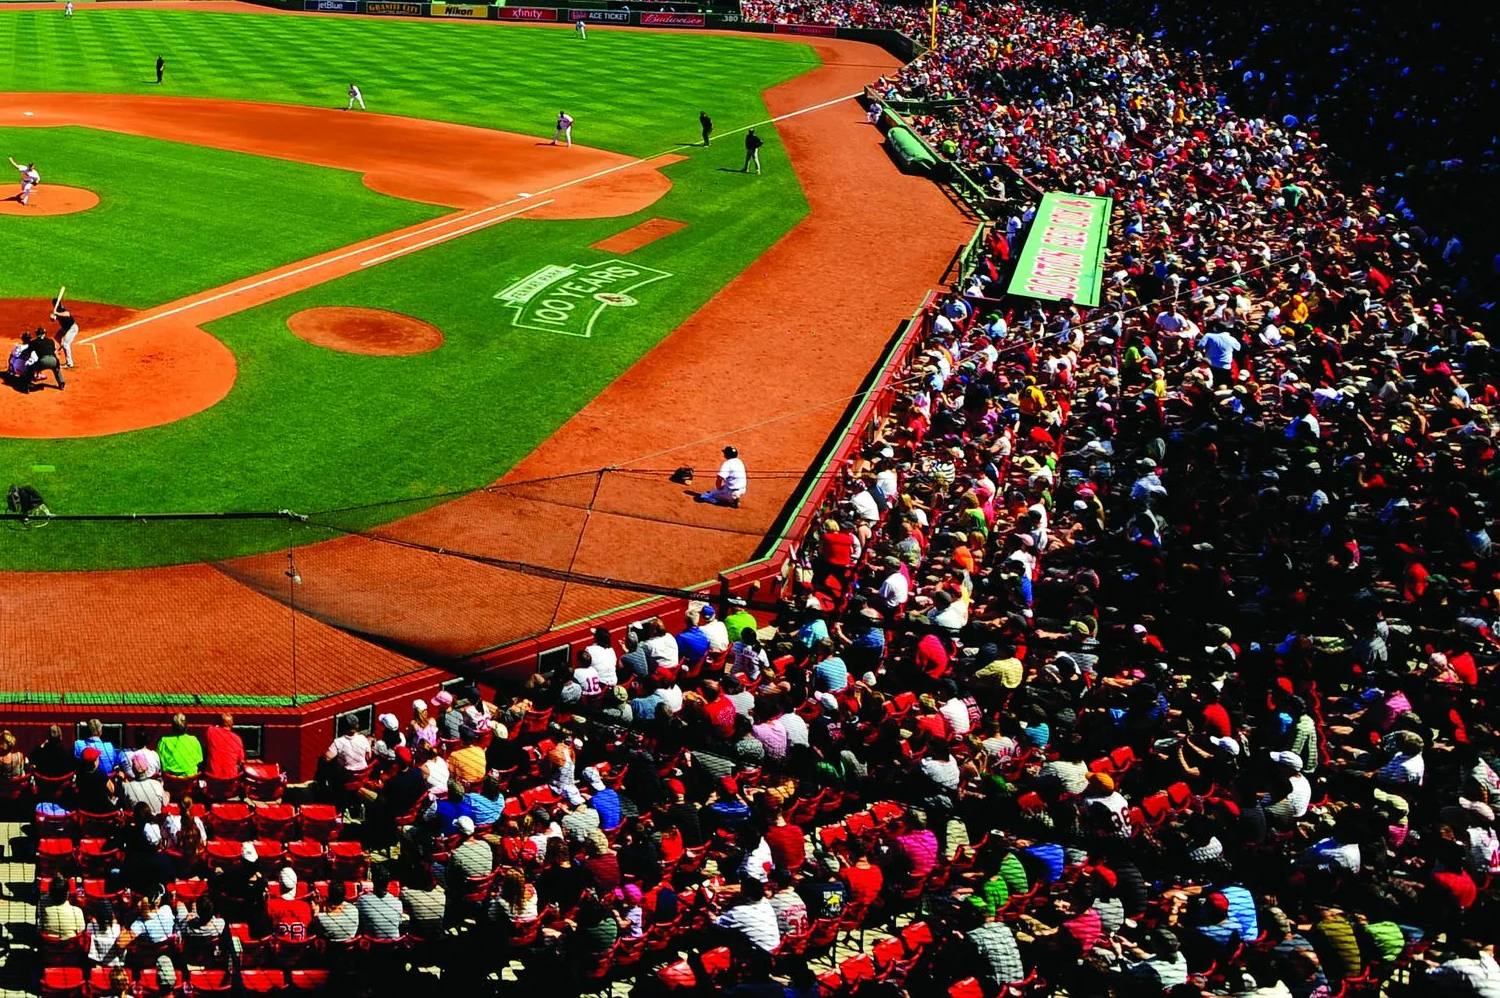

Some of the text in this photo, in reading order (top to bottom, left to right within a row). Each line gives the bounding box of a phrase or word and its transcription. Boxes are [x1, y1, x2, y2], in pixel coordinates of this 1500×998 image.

[318, 2, 343, 11] jetBlue
[369, 4, 400, 12] GRANITE
[445, 6, 473, 16] Nikon
[512, 8, 543, 19] xfinity
[589, 12, 602, 20] ACE
[644, 13, 702, 24] Budweiser
[532, 266, 640, 326] 100 YEARS
